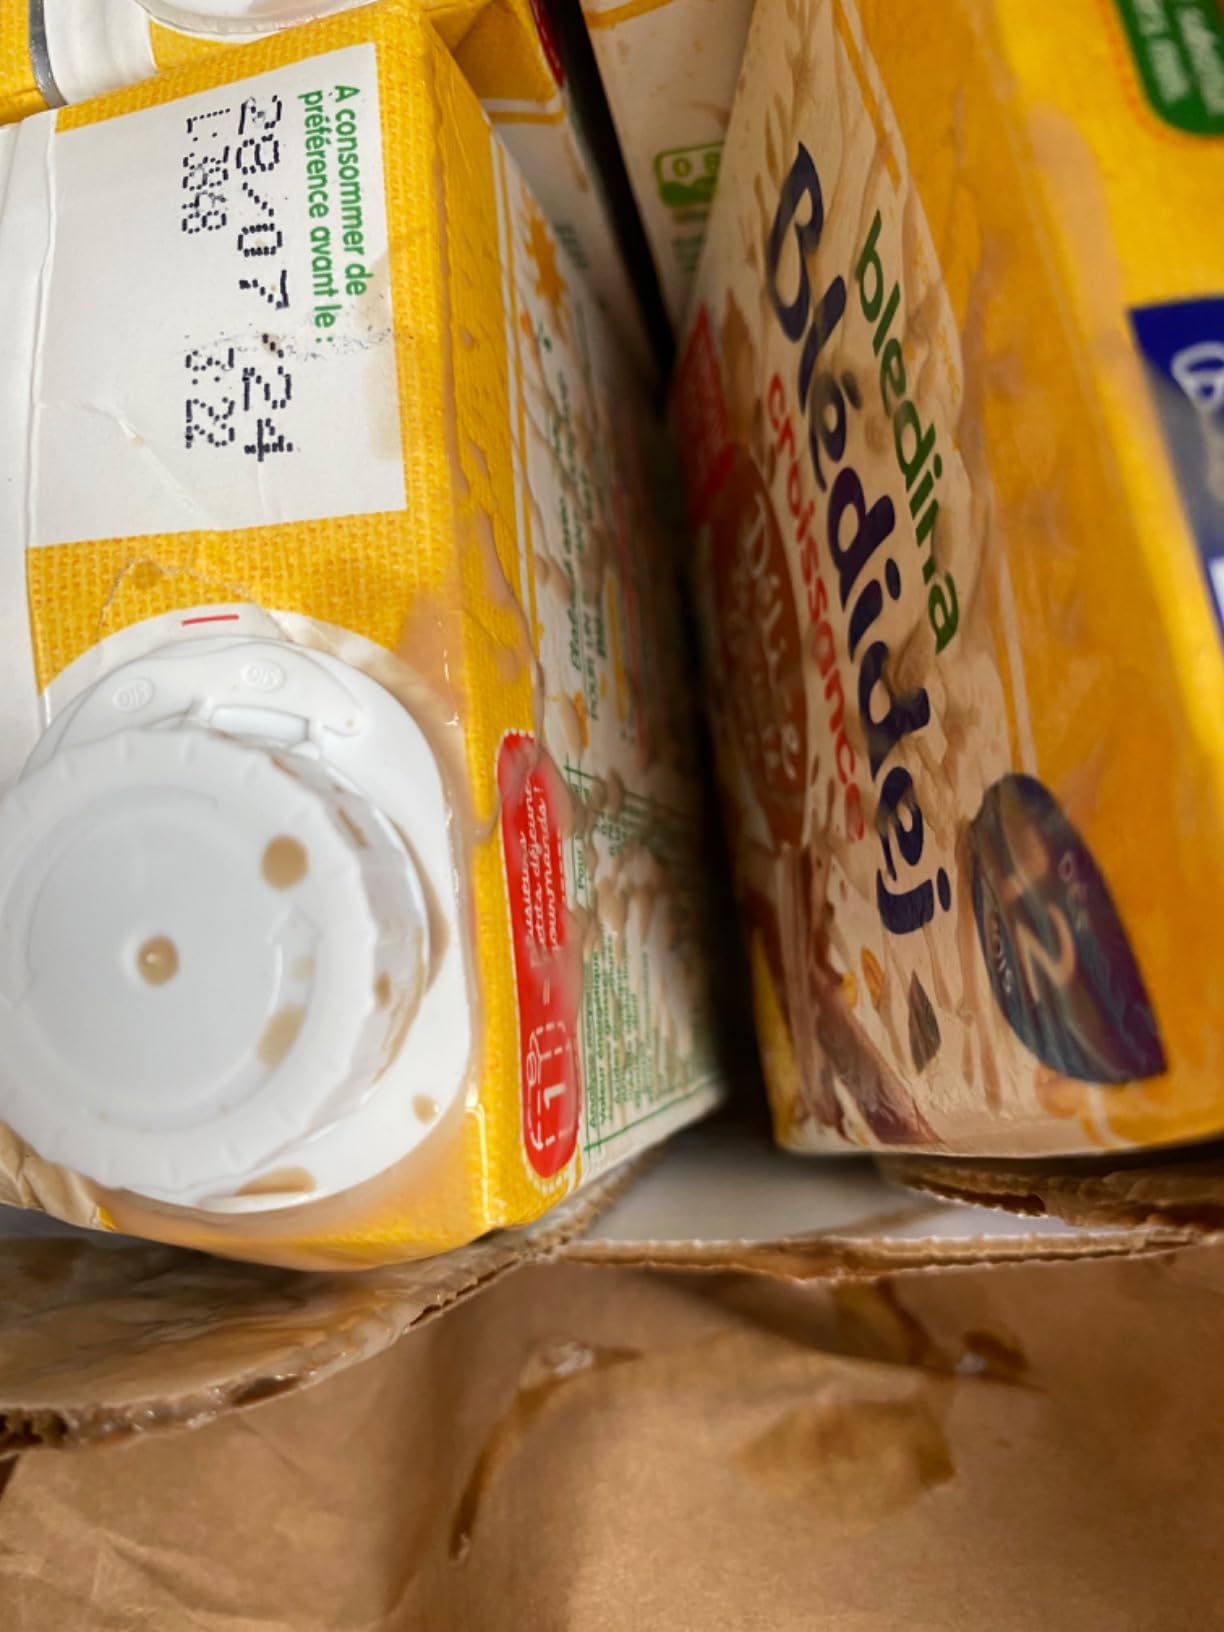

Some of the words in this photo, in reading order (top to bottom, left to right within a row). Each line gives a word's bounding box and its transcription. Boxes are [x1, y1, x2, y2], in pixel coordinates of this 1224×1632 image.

[334, 85, 361, 102] A
[297, 90, 333, 219] préférence
[334, 108, 365, 256] consommer
[309, 226, 339, 298] avant
[344, 262, 374, 296] de
[314, 303, 343, 328] le
[767, 372, 865, 844] croissance
[524, 766, 543, 878] déjeune
